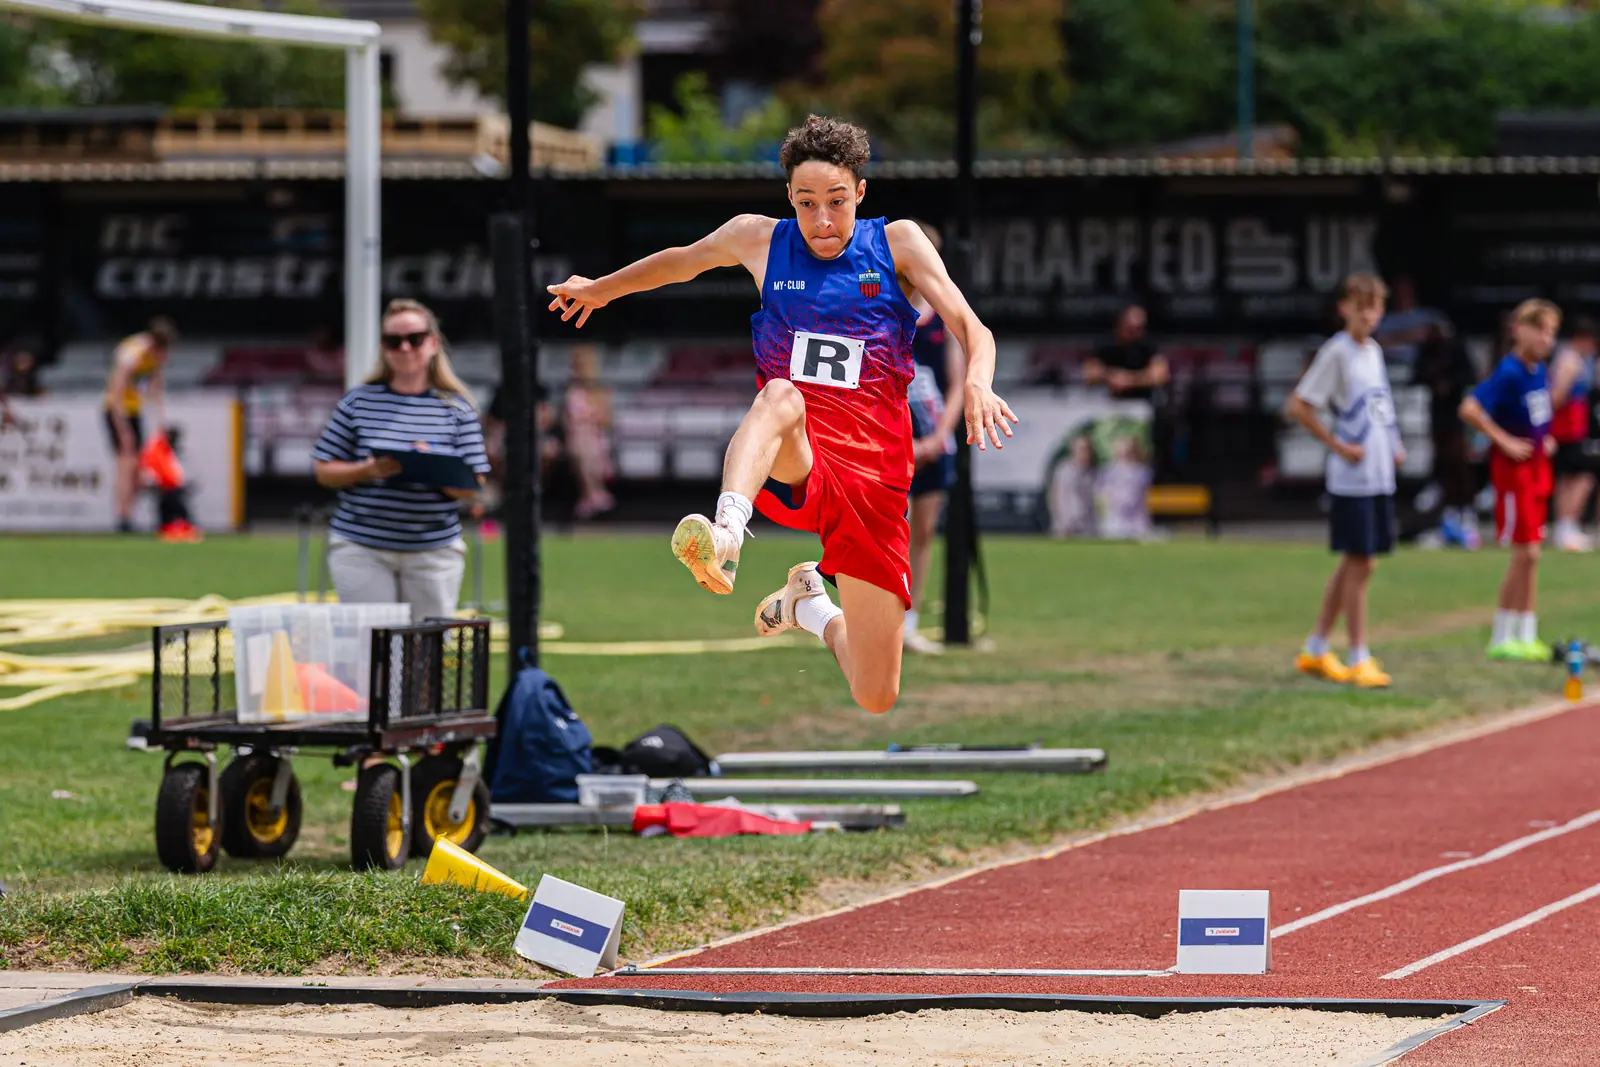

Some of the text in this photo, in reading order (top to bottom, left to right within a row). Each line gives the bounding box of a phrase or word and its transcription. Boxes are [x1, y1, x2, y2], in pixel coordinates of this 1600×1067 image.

[95, 246, 573, 299] constrctin
[1303, 216, 1377, 293] UK
[803, 338, 850, 382] R
